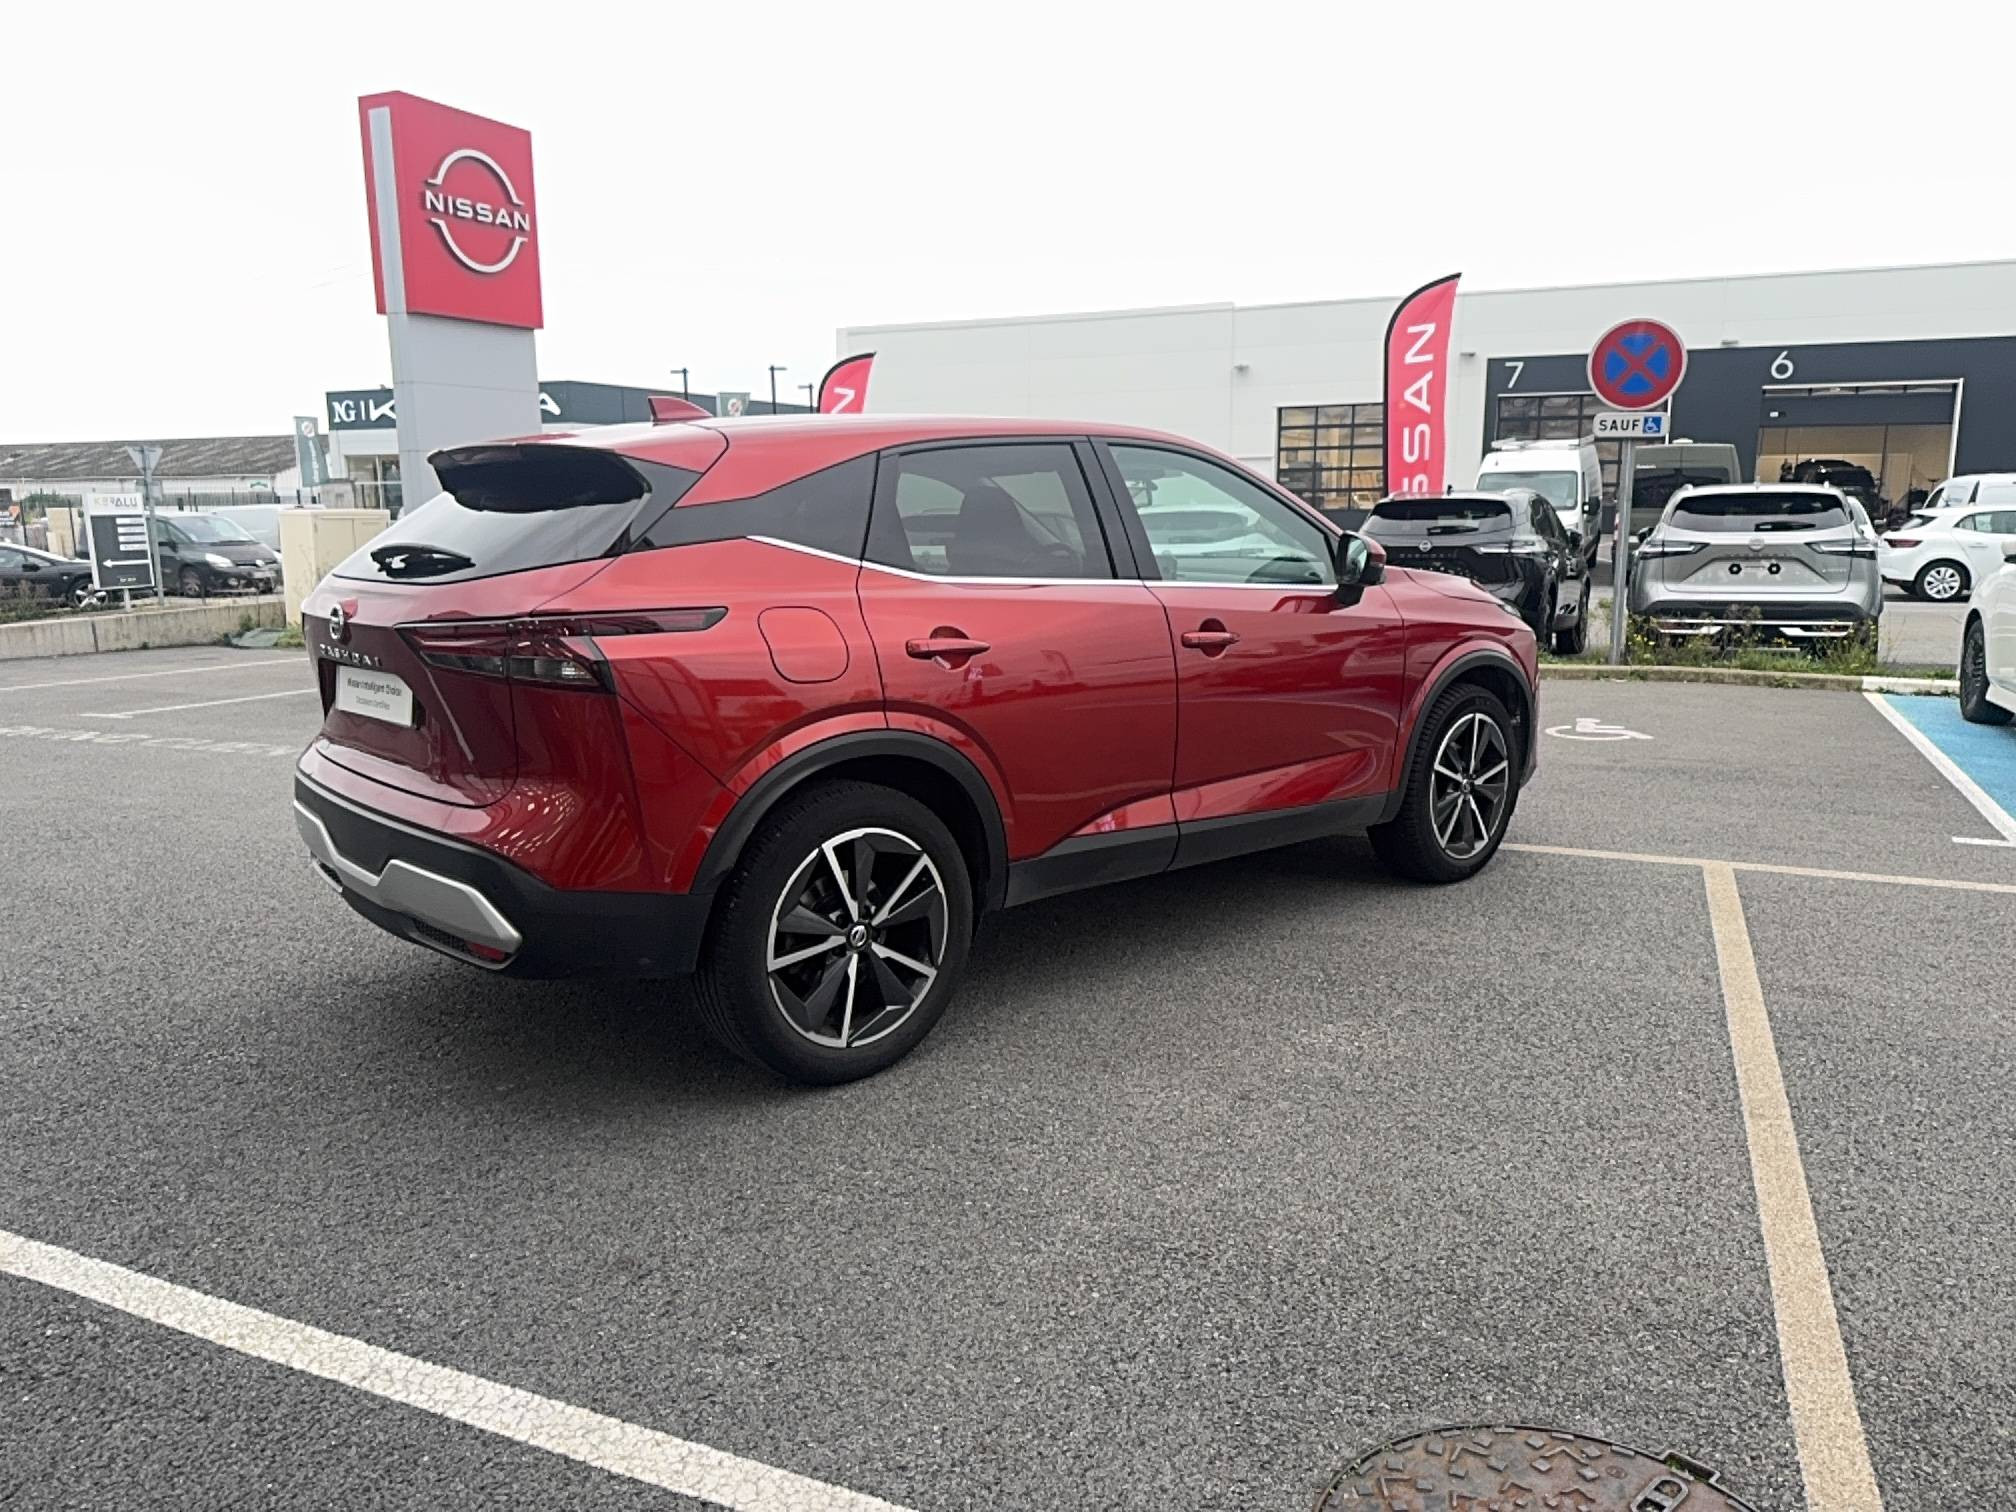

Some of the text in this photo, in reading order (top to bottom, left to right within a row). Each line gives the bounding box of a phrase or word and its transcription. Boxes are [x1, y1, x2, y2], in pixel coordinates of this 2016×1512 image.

[425, 189, 530, 231] NISSAN
[1505, 361, 1524, 388] 7
[1770, 351, 1794, 379] 6
[1402, 322, 1437, 497] SSAN
[1598, 419, 1641, 432] SAUF
